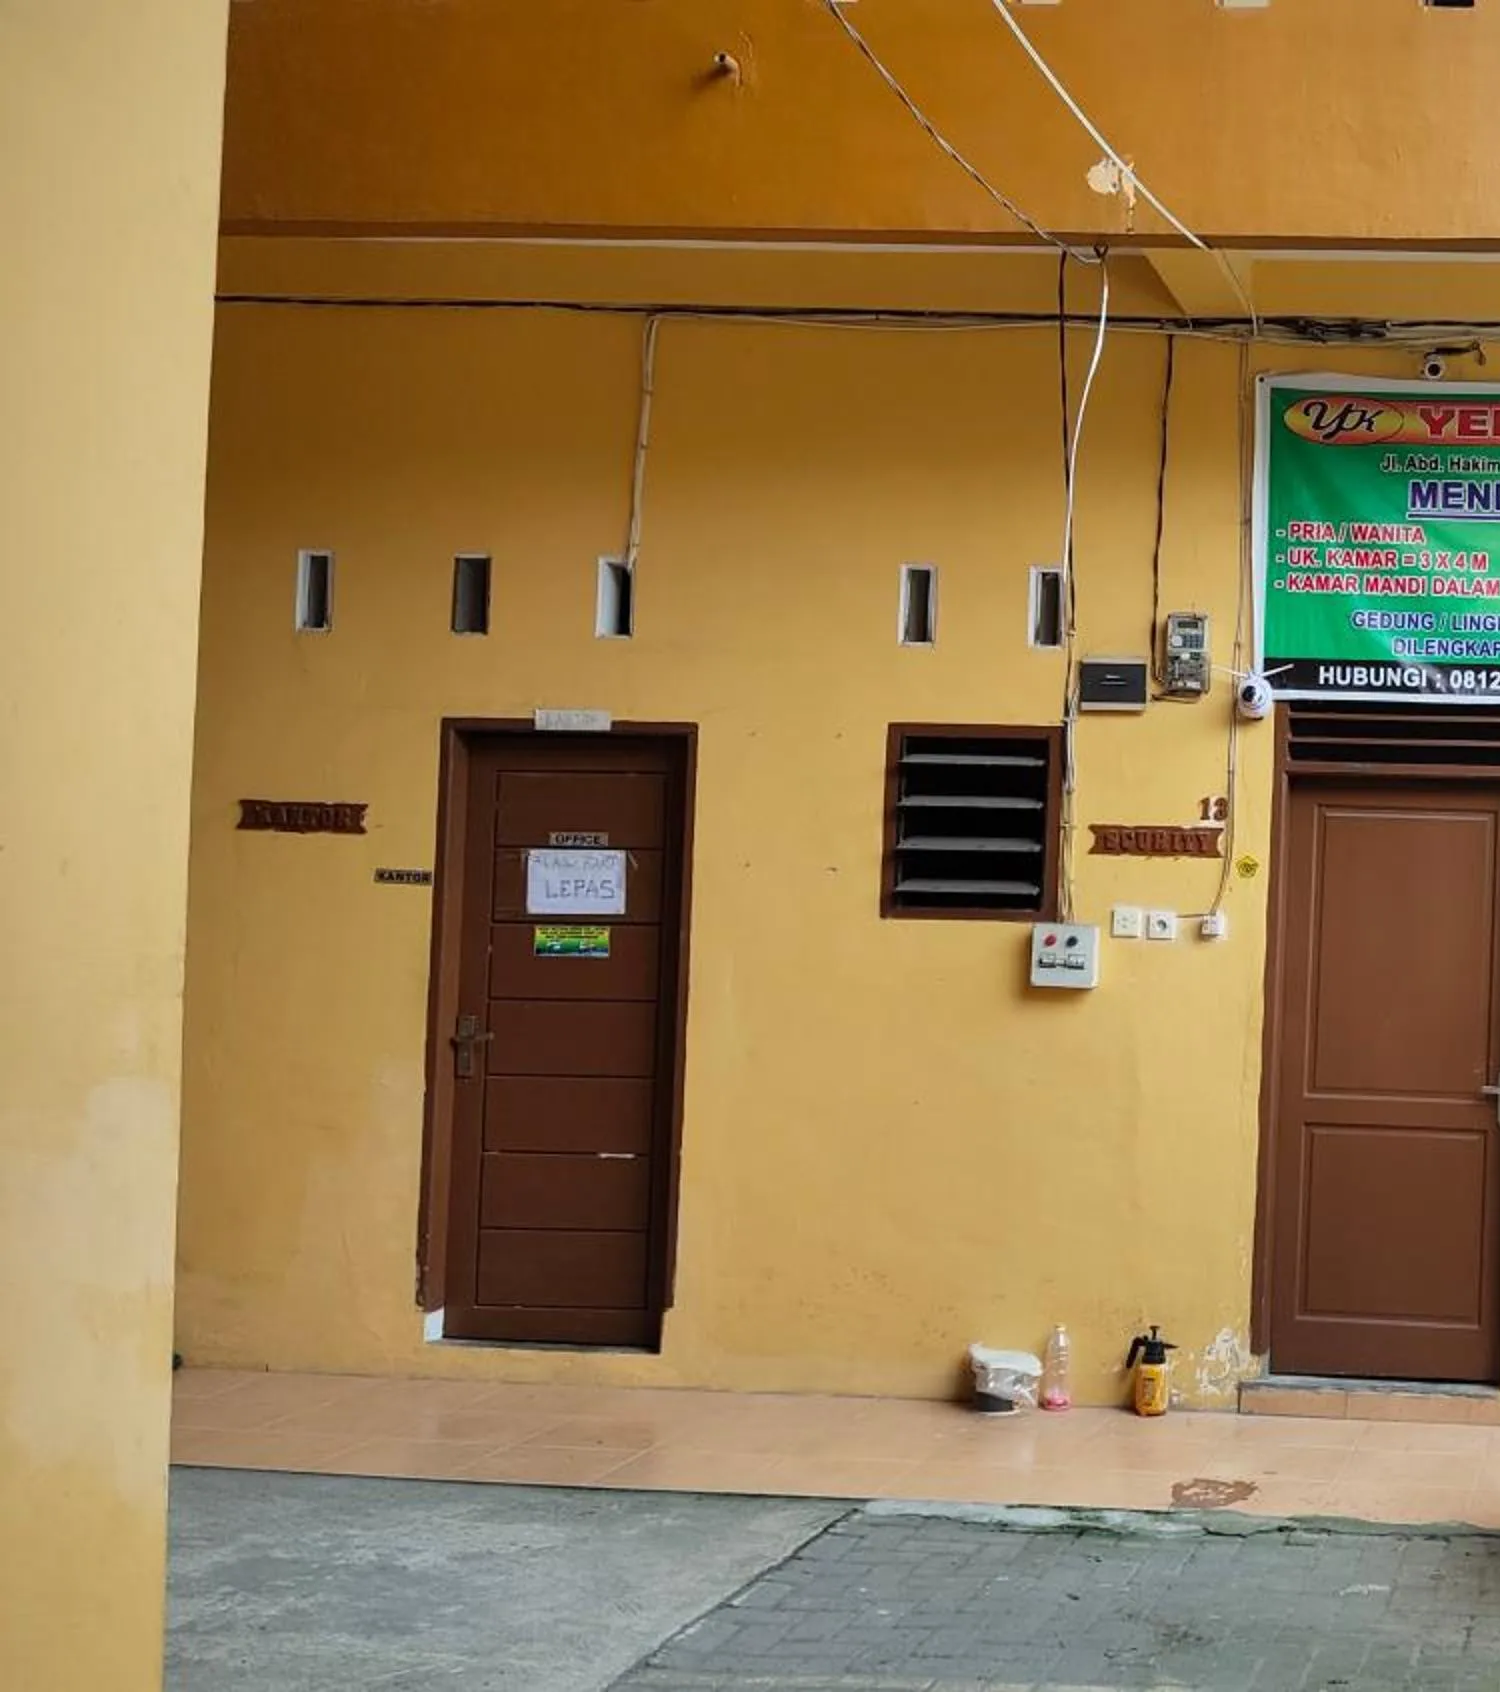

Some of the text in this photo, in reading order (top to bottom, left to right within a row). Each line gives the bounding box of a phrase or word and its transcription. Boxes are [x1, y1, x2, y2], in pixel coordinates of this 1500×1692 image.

[1405, 452, 1443, 473] Abd.
[1288, 521, 1335, 542] PRIA
[1349, 523, 1426, 543] WANITA
[1288, 549, 1321, 567] UK.
[1326, 550, 1399, 569] KAMAR
[1420, 552, 1433, 570] 3
[1436, 552, 1451, 569] X
[1454, 552, 1467, 571] 4
[1470, 553, 1488, 572] M
[1286, 574, 1359, 594] KAMAR
[1364, 575, 1426, 596] MANDI
[1351, 611, 1434, 631] GEDUNG
[1318, 666, 1427, 687] HUBUNGI
[1199, 797, 1229, 821] 13
[555, 834, 603, 845] OFFICE
[378, 869, 432, 882] KANTOR
[545, 879, 616, 900] LEPAS
